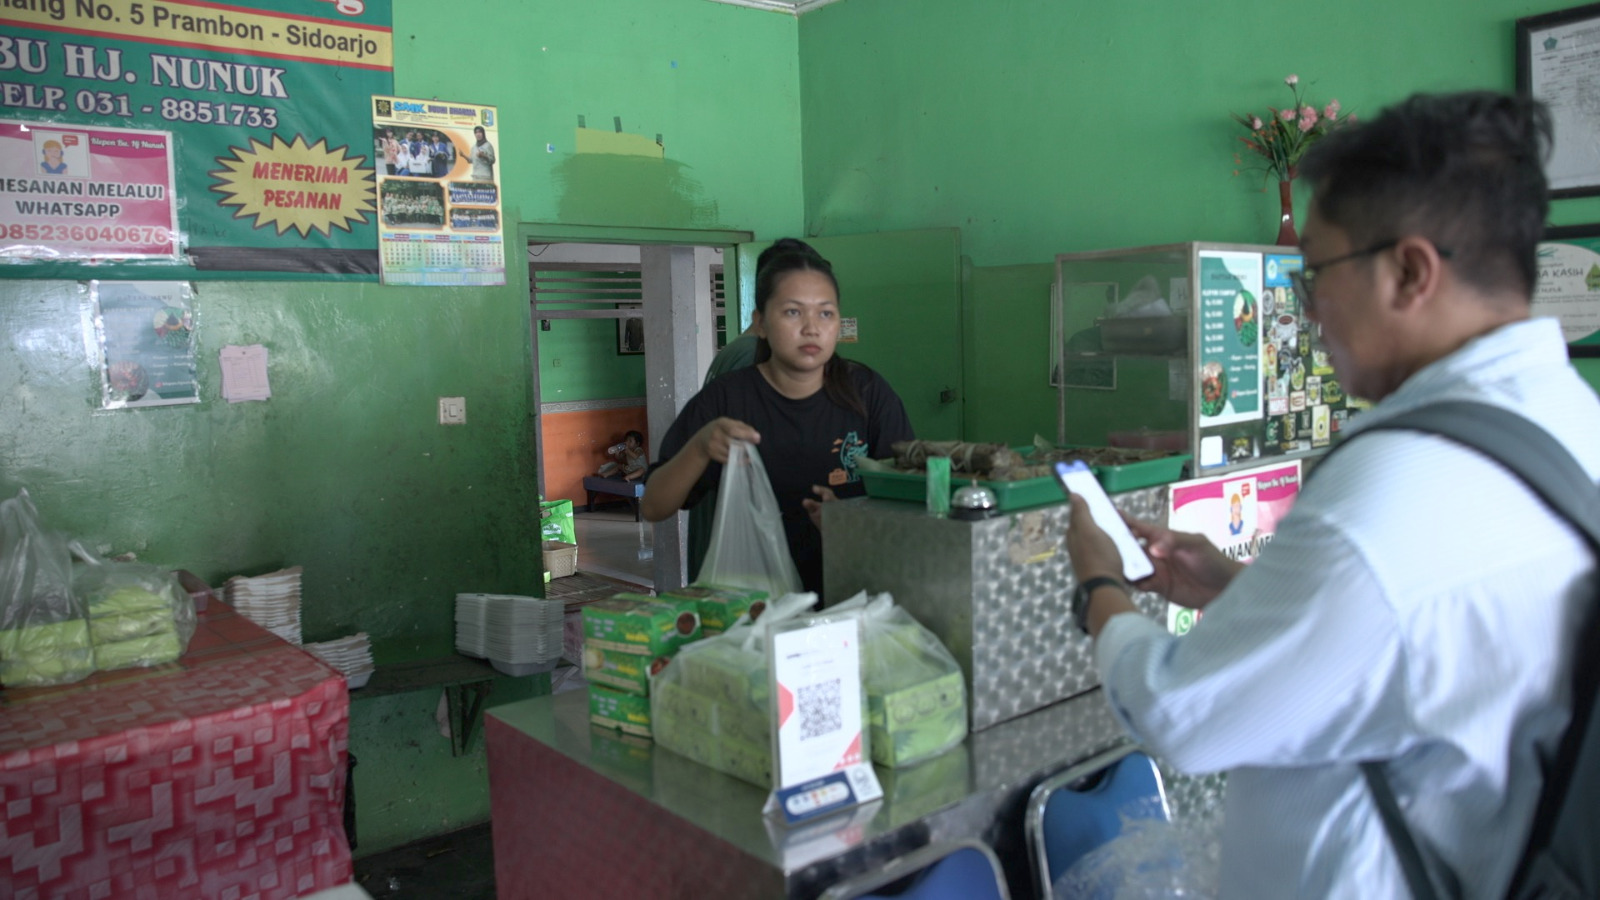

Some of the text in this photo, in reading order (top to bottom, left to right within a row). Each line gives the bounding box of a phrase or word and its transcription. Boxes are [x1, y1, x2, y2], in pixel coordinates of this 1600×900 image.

[75, 0, 121, 22] No.
[130, 3, 145, 25] 5
[152, 6, 264, 41] Prambon
[286, 24, 377, 58] Sidoarjo
[63, 43, 137, 83] HJ.
[150, 53, 288, 98] NUNUK
[0, 82, 67, 110] ELP.
[76, 89, 133, 117] 031
[160, 97, 278, 129] 8851733
[393, 101, 426, 113] SMK
[252, 161, 349, 185] MENERIMA
[88, 182, 163, 199] MELALUI
[263, 189, 342, 211] PESANAN
[15, 200, 120, 217] WHATSAPP
